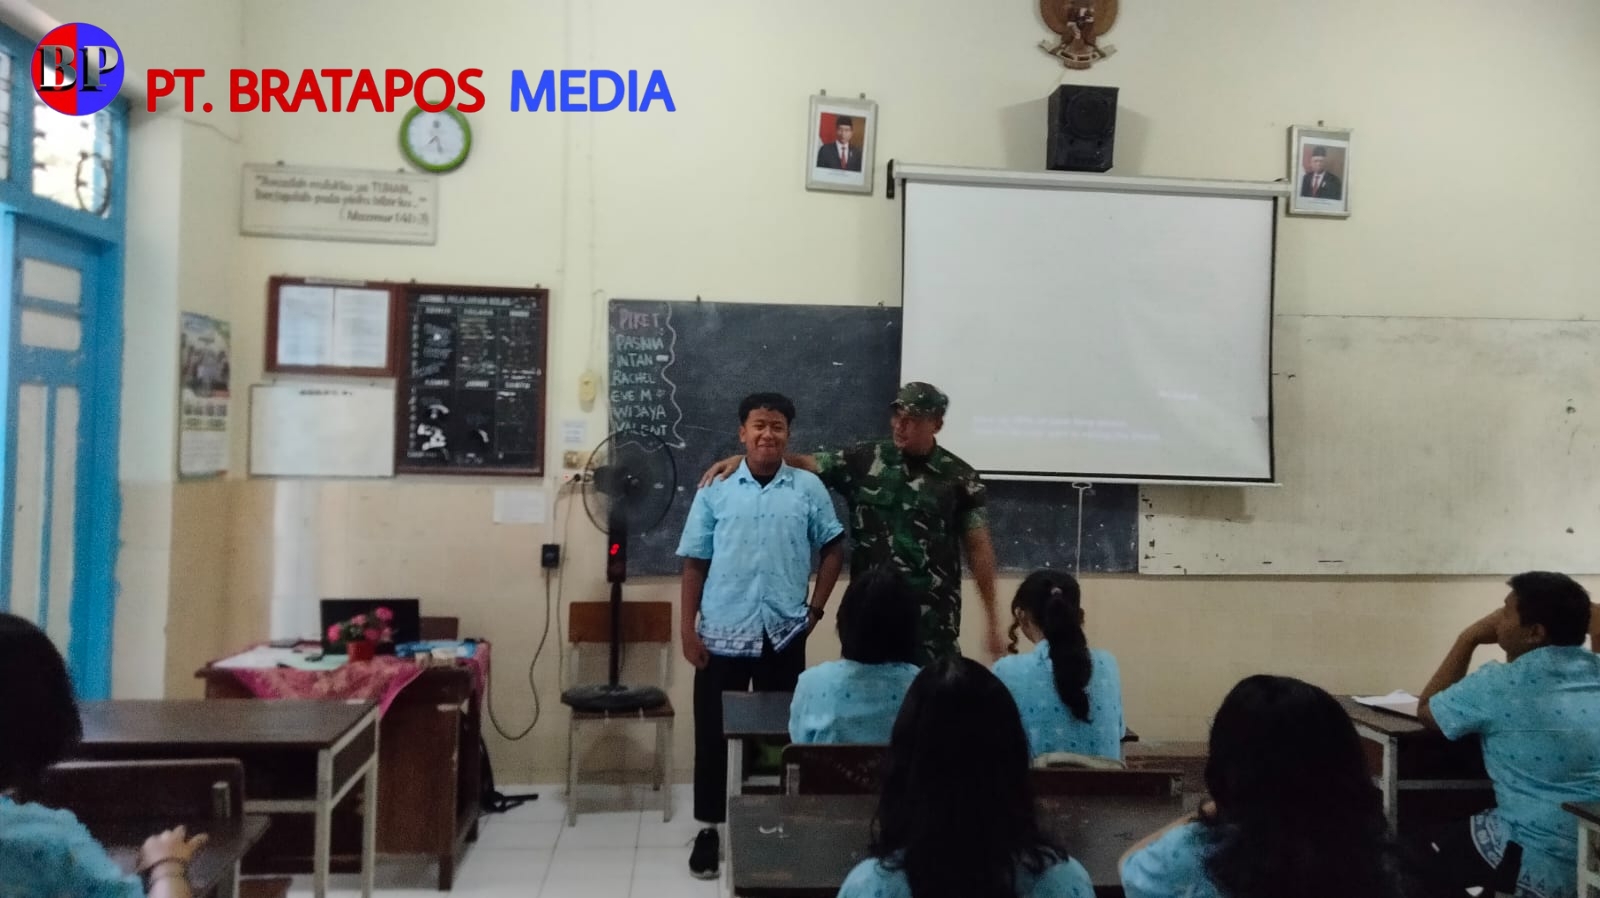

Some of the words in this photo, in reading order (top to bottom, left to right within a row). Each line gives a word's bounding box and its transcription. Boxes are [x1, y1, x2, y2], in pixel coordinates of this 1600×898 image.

[616, 352, 653, 367] INTAN
[612, 369, 656, 386] RACHEL
[640, 389, 652, 401] M
[613, 404, 667, 421] WIJAYA
